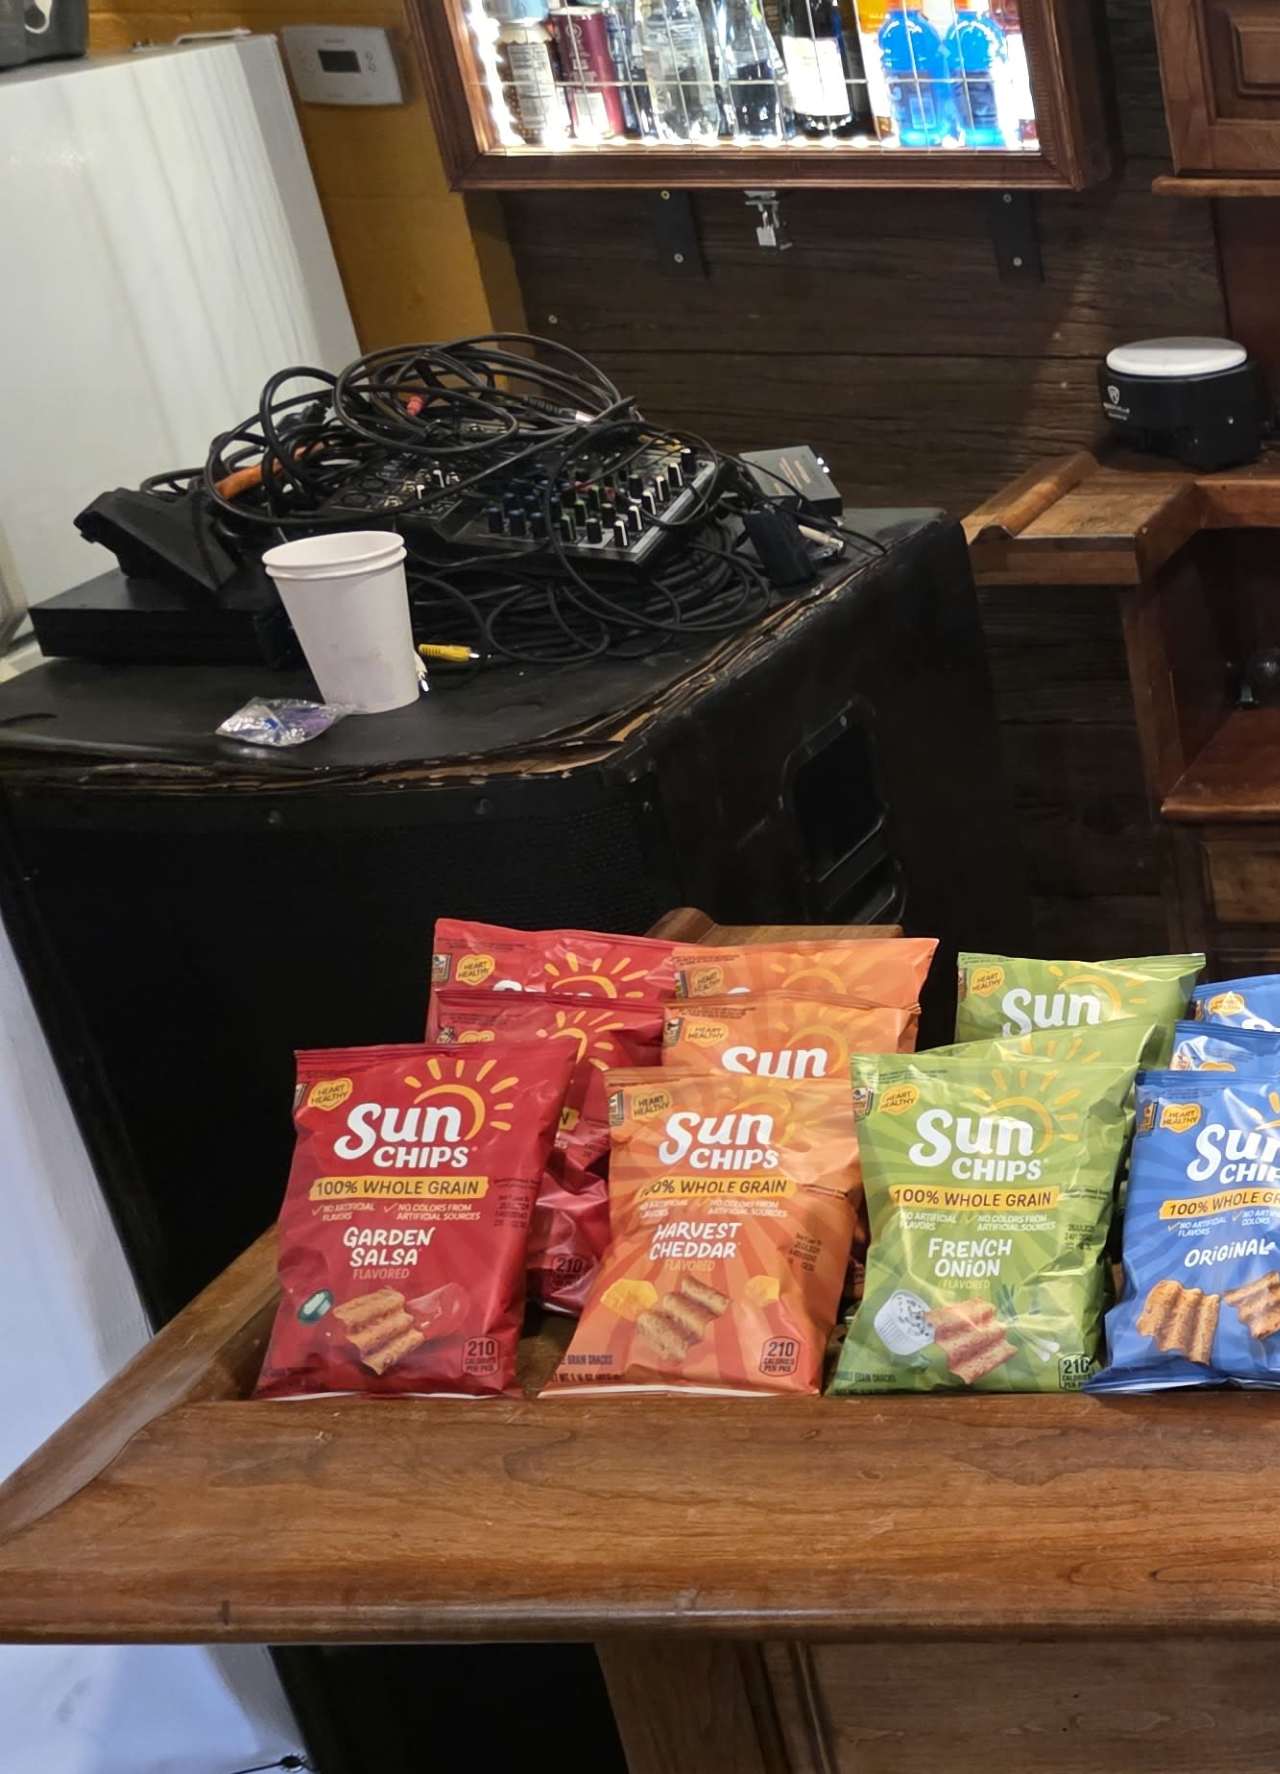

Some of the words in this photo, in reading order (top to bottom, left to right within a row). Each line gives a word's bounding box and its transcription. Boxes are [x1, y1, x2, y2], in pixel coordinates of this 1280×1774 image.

[1001, 988, 1101, 1036] Sun
[721, 1046, 827, 1078] Sun
[334, 1102, 461, 1160] Sun
[658, 1111, 774, 1165] Sun
[908, 1109, 1034, 1167] Sun
[373, 1146, 469, 1168] CHIPS
[689, 1149, 779, 1170] CHIPS
[952, 1158, 1042, 1182] CHIPS
[317, 1180, 357, 1196] 100%
[364, 1180, 423, 1195] WHOLE
[428, 1180, 478, 1195] GRAIN
[681, 1180, 736, 1194] WHOLE
[739, 1180, 787, 1194] GRAIN
[894, 1189, 939, 1205] 100%
[945, 1191, 1000, 1207] WHOLE
[1006, 1191, 1051, 1207] GRAIN
[1170, 1199, 1208, 1216] 100%
[1212, 1192, 1260, 1211] WHOLE
[343, 1226, 435, 1249] GARDEN
[653, 1221, 742, 1243] HARVEST
[349, 1247, 418, 1267] SALSA
[649, 1242, 737, 1261] CHEDDAR
[928, 1238, 1012, 1258] FRENCH
[353, 1268, 410, 1280] FLAVORED
[556, 1258, 582, 1273] 210
[468, 1340, 495, 1357] 210
[768, 1341, 795, 1357] 210
[1063, 1359, 1090, 1373] 210
